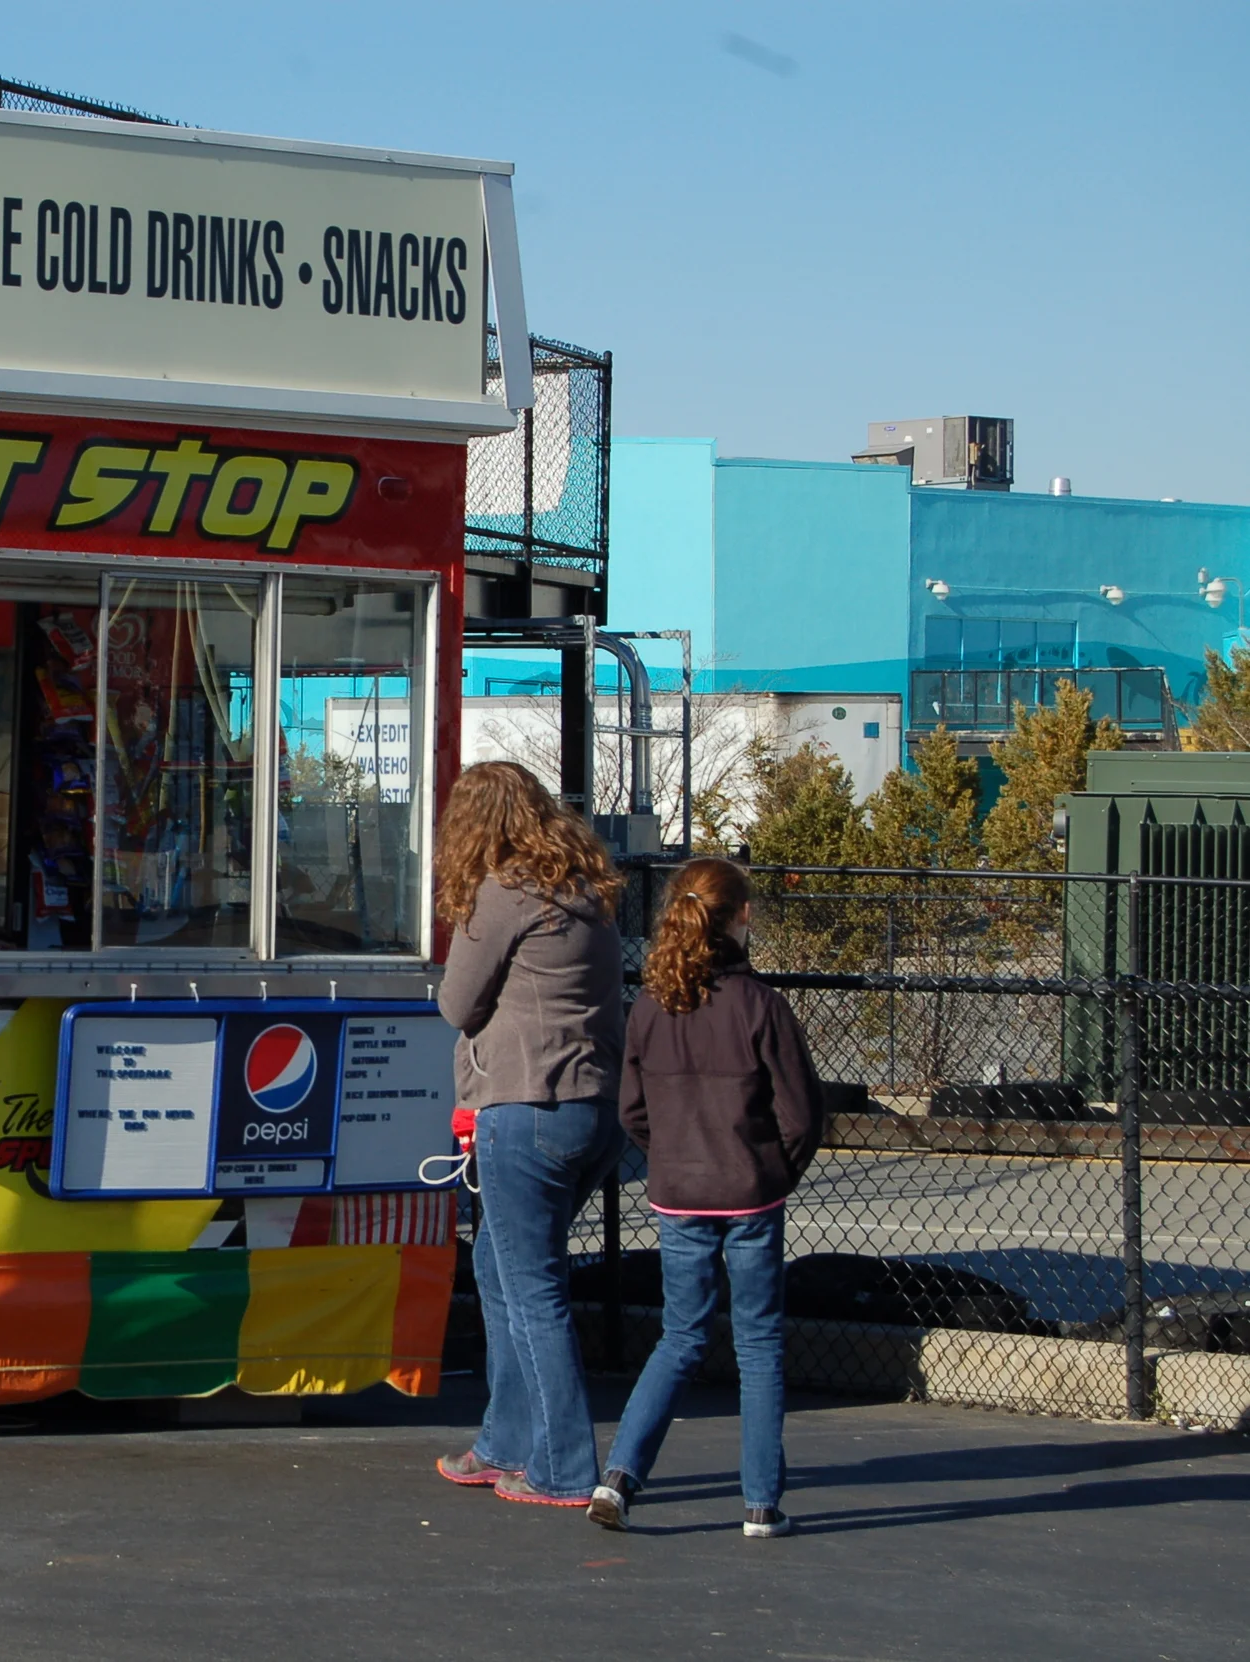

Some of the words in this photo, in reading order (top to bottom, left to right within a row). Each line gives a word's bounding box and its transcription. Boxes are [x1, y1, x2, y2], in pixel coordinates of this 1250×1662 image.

[37, 199, 132, 295] COLD
[147, 210, 284, 310] DRINKS
[322, 226, 467, 325] SNACKS
[106, 651, 136, 664] OOD
[96, 1045, 145, 1056] WELCOME
[3, 1093, 54, 1135] The
[243, 1118, 309, 1145] pepsi
